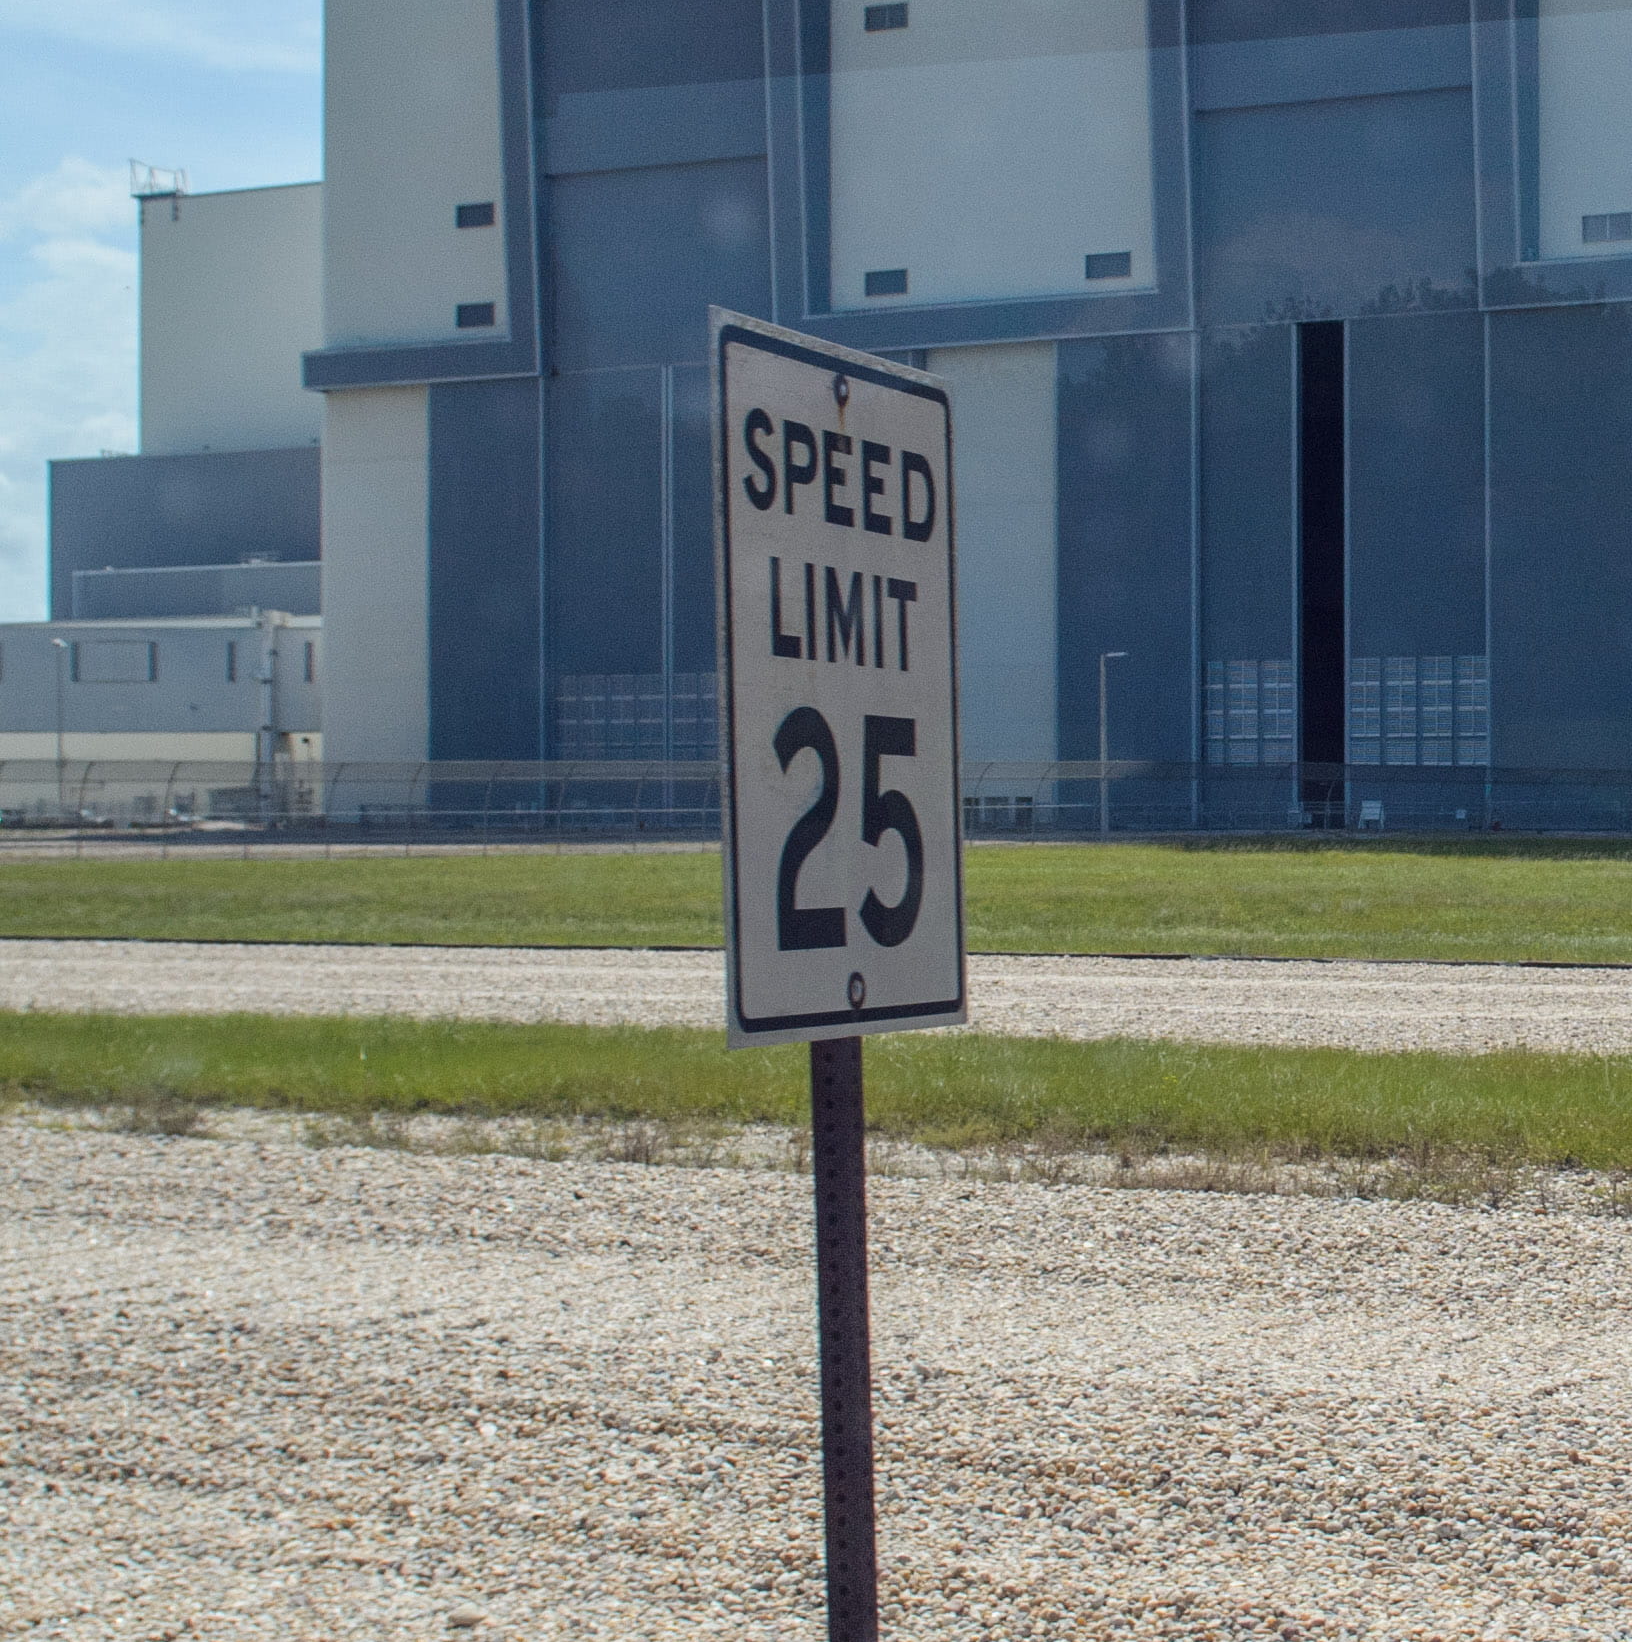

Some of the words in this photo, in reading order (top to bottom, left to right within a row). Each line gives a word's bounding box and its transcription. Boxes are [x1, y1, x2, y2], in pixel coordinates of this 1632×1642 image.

[743, 407, 935, 543] SPEED
[770, 556, 917, 671] LIMIT
[774, 706, 925, 951] 25
